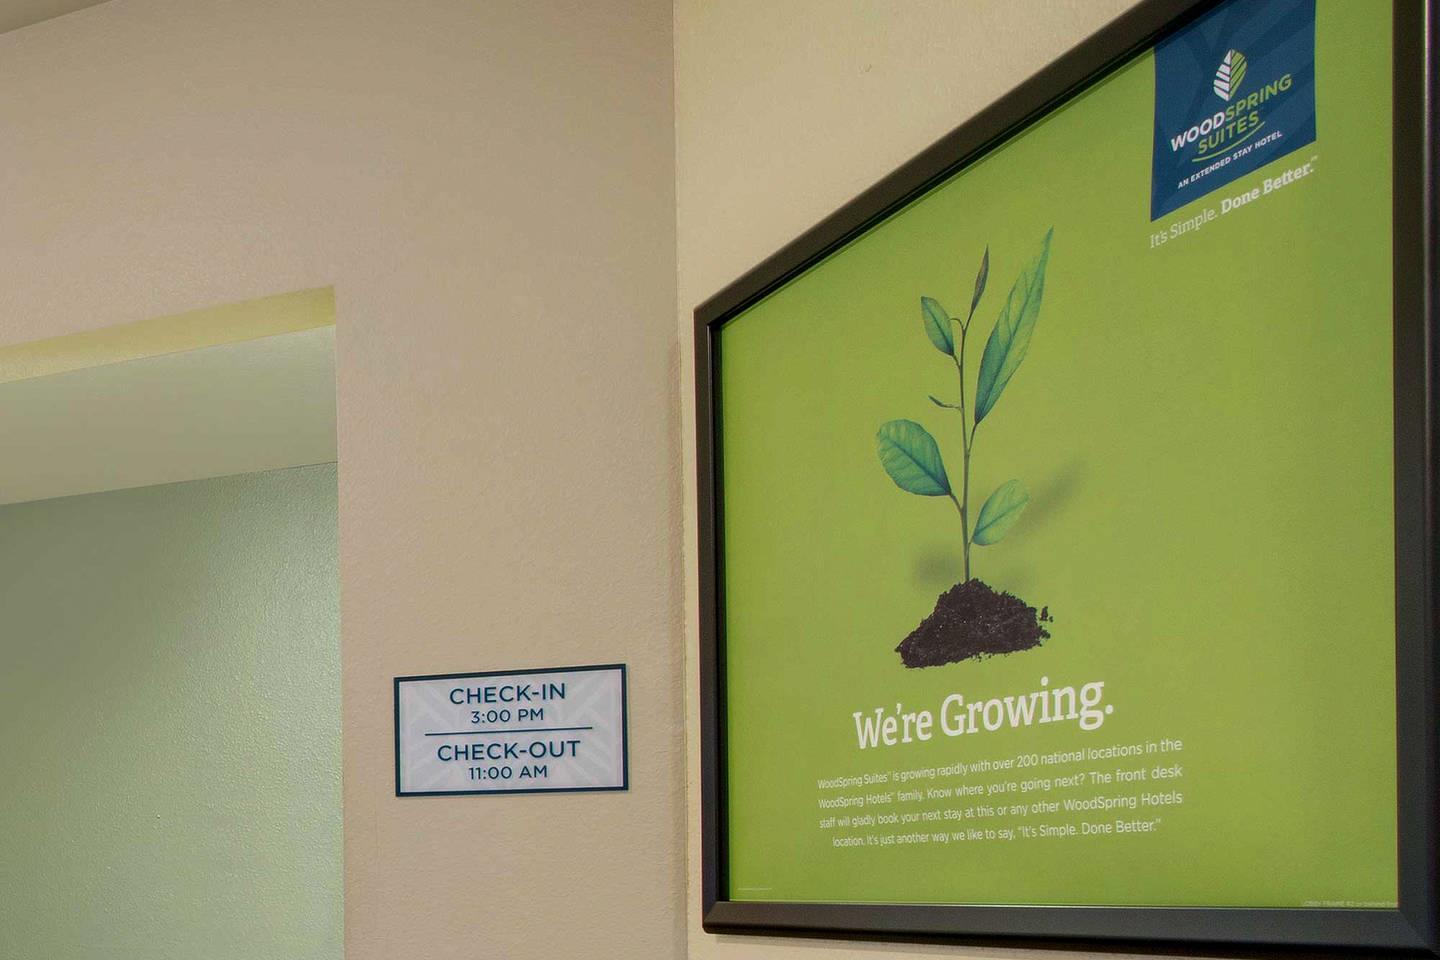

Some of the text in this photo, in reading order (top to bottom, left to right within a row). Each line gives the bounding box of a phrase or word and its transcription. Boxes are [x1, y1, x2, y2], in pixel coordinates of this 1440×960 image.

[1171, 74, 1293, 152] WOODSPRING
[1197, 111, 1259, 154] SUITES
[1178, 130, 1282, 189] AN EXTENDED STAY HOTEL
[1150, 231, 1168, 248] It's
[1170, 207, 1218, 240] Simple.
[1221, 188, 1261, 214] Done
[449, 682, 566, 705] CHECK-IN
[853, 676, 1114, 750] We're Growing.
[471, 708, 544, 724] 3:00 PM
[437, 740, 581, 761] CHECK-OUT
[817, 775, 863, 789] WoodSpring
[892, 770, 900, 782] is
[901, 766, 936, 782] growing
[937, 762, 968, 776] rapidly
[969, 759, 991, 773] with
[993, 759, 1015, 770] over
[1016, 754, 1038, 768] 200
[1041, 748, 1085, 765] national
[1088, 743, 1143, 760] locations
[1146, 740, 1158, 753] in
[1160, 738, 1183, 752] the
[469, 765, 548, 780] 11:00 AM
[818, 795, 864, 809] WoodSpring
[927, 786, 952, 798] Know
[955, 783, 984, 797] where
[986, 782, 1017, 796] you're
[1020, 777, 1051, 793] going
[1054, 773, 1085, 787] next?
[1089, 771, 1112, 785] The
[1116, 768, 1147, 782] front
[1151, 763, 1183, 780] desk
[819, 790, 1183, 829] staff will gladly book your next stay at this or any other WoodSpring Hotels
[832, 835, 864, 848] location.
[866, 834, 879, 846] It's
[879, 834, 895, 846] just
[896, 831, 930, 844] another
[931, 832, 950, 844] way
[952, 831, 965, 841] we
[967, 828, 983, 840] like
[985, 829, 996, 840] to
[1039, 823, 1078, 838] Simple.
[1081, 821, 1112, 835] Done
